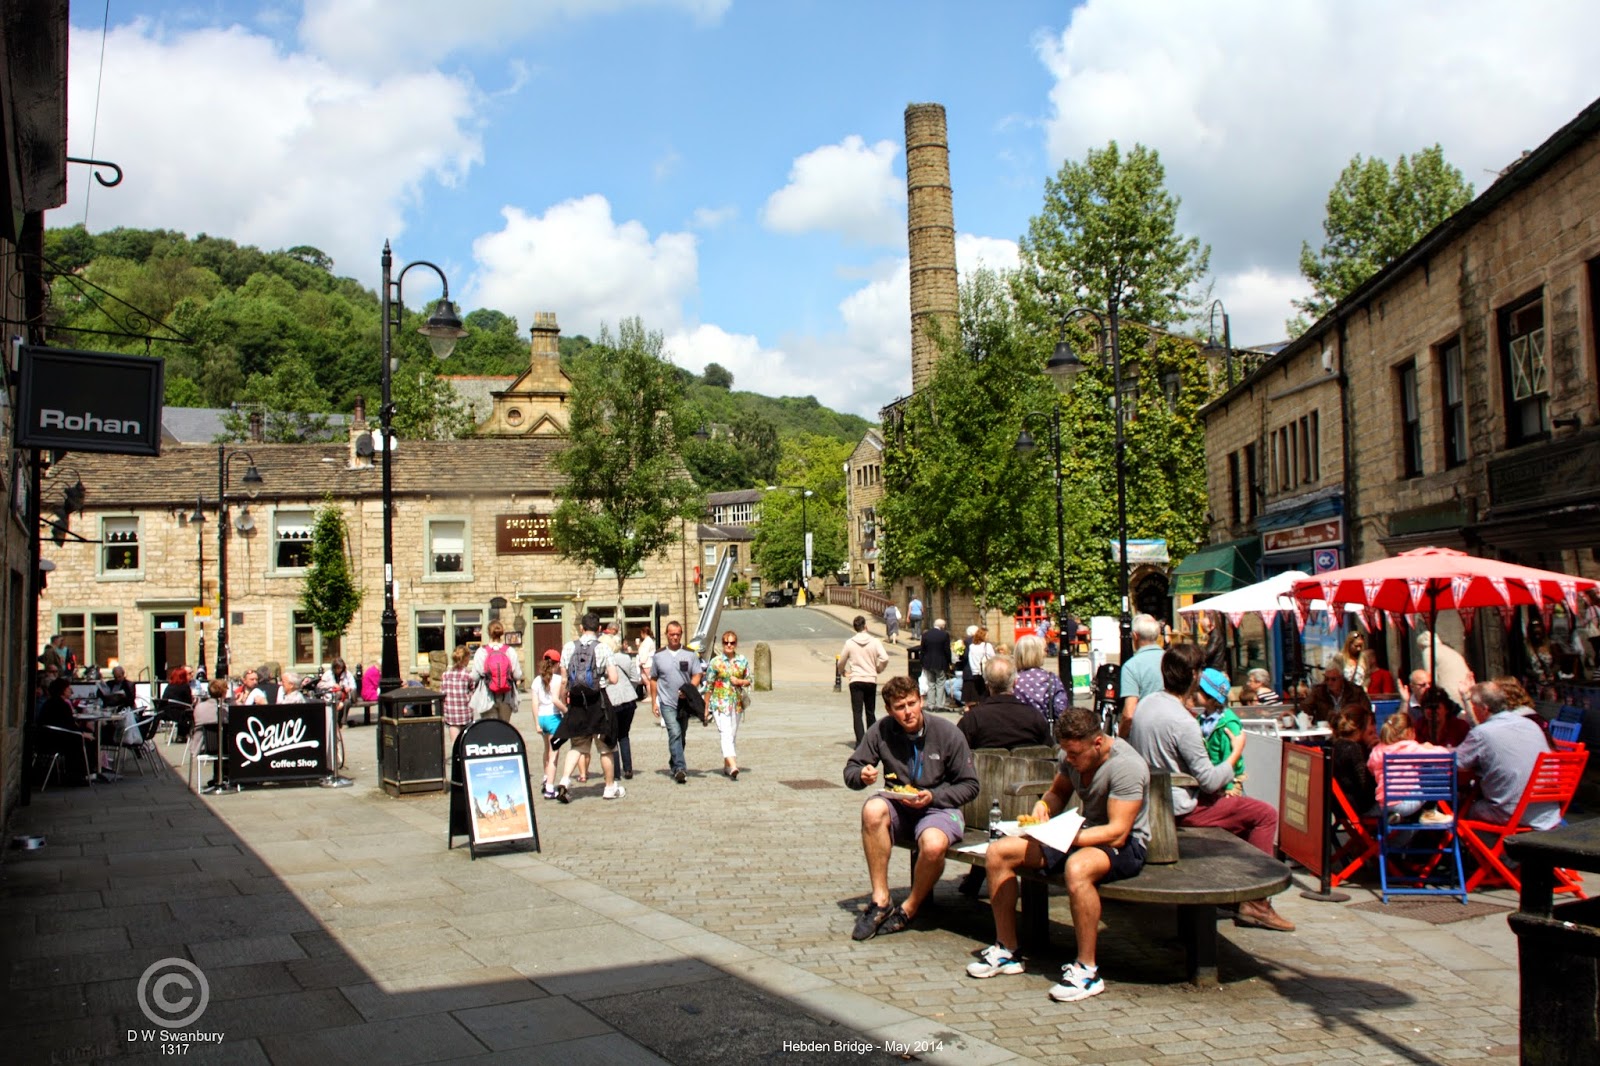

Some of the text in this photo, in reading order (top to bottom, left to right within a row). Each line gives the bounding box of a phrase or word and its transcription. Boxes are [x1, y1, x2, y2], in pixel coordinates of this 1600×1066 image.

[40, 409, 140, 435] Rohan
[528, 529, 538, 537] OF
[511, 537, 554, 547] MUTTON
[236, 716, 319, 767] Sauce
[466, 743, 518, 756] Rohan
[270, 758, 318, 769] Coffee Shop
